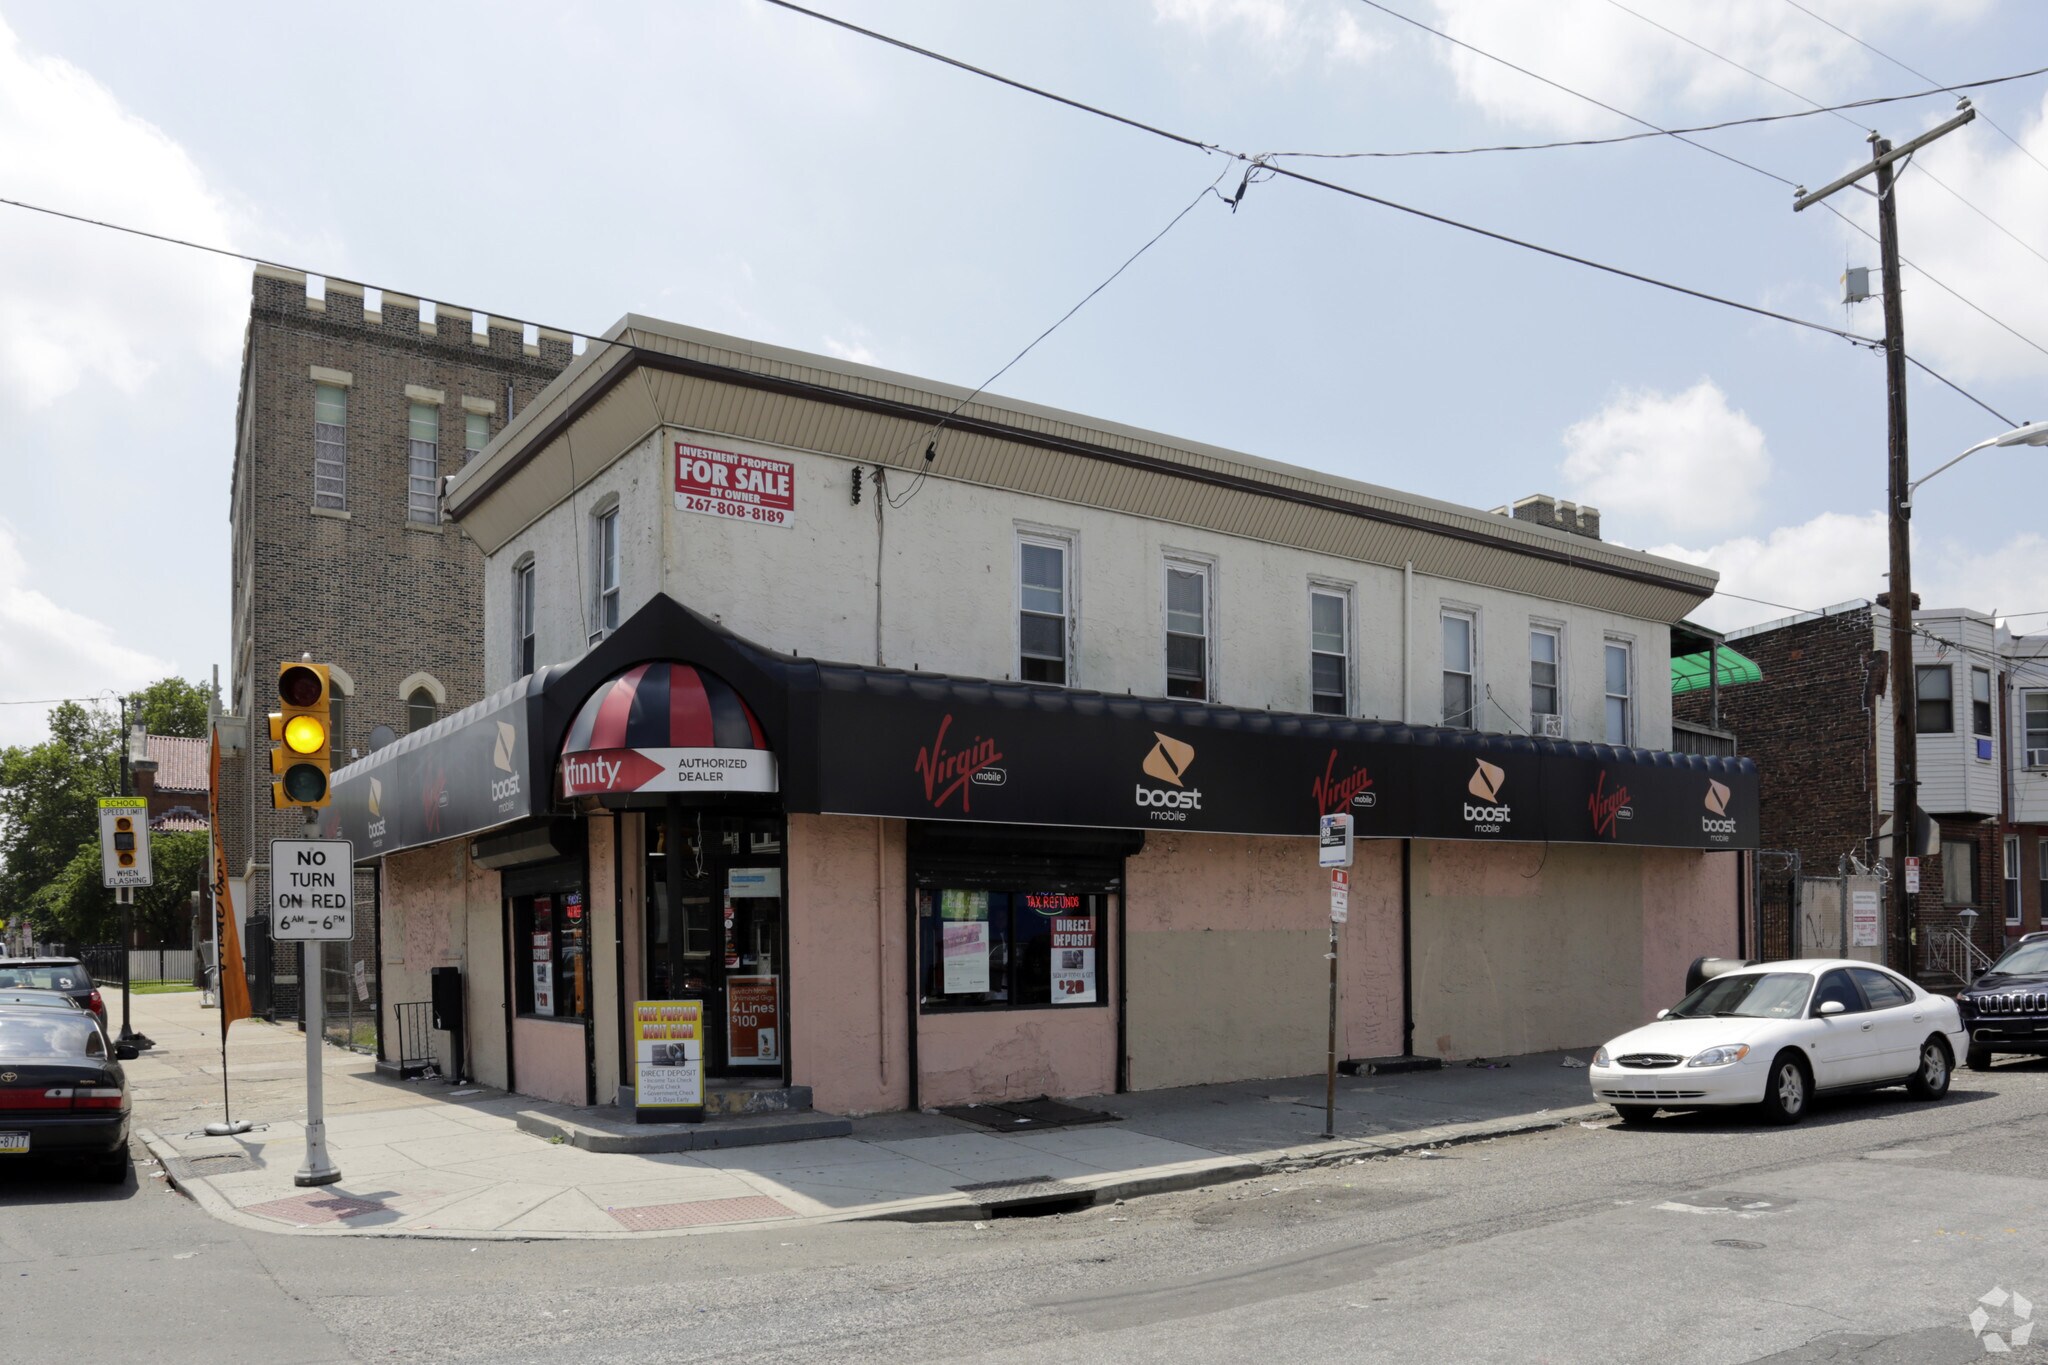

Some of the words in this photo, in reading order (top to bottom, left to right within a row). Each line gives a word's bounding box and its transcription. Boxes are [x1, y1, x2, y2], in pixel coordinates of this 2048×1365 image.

[680, 445, 739, 465] INVESTMENT
[741, 456, 790, 473] PROPERTY
[680, 457, 729, 487] FOR
[735, 467, 790, 497] SALE
[710, 486, 722, 497] BY
[725, 489, 761, 503] OWNER
[686, 496, 785, 523] 267-808-8189
[678, 758, 748, 769] AUTHORIZED
[915, 714, 1003, 813] Virgin
[565, 756, 622, 789] xfinity
[678, 772, 724, 782] DEALER
[975, 771, 1002, 782] mobile
[492, 772, 521, 801] boost
[1312, 749, 1373, 816] Virgin
[1136, 783, 1202, 810] boost
[1354, 795, 1374, 804] mobile
[498, 800, 515, 813] mobile
[1588, 769, 1631, 839] Virgin
[103, 808, 125, 816] SPEED
[127, 808, 143, 816] LIMIT
[1150, 810, 1187, 822] mobile
[1464, 802, 1511, 823] boost
[1617, 809, 1632, 817] mobile
[368, 816, 387, 839] boost
[1321, 827, 1331, 837] 89
[1474, 823, 1501, 833] mobile
[1702, 816, 1737, 834] boost
[1710, 834, 1730, 843] mobile
[297, 851, 326, 866] NO
[109, 877, 147, 885] FLASHING
[290, 873, 335, 887] TURN
[279, 894, 302, 909] ON
[312, 894, 346, 909] RED
[1026, 896, 1041, 908] TAX
[1043, 896, 1079, 908] REFUNDS
[280, 915, 304, 930] 6AM
[323, 915, 345, 930] 6PM
[1056, 919, 1089, 931] DIRECT
[1053, 934, 1092, 946] DEPOSIT
[638, 1006, 658, 1021] FREE
[660, 1006, 697, 1021] PREPAID
[732, 1002, 740, 1013] 4
[742, 1002, 775, 1013] Lines
[732, 1015, 758, 1027] $100
[643, 1024, 667, 1039] DEBIT
[670, 1024, 694, 1039] CARD
[667, 1069, 696, 1077] DEPOSIT
